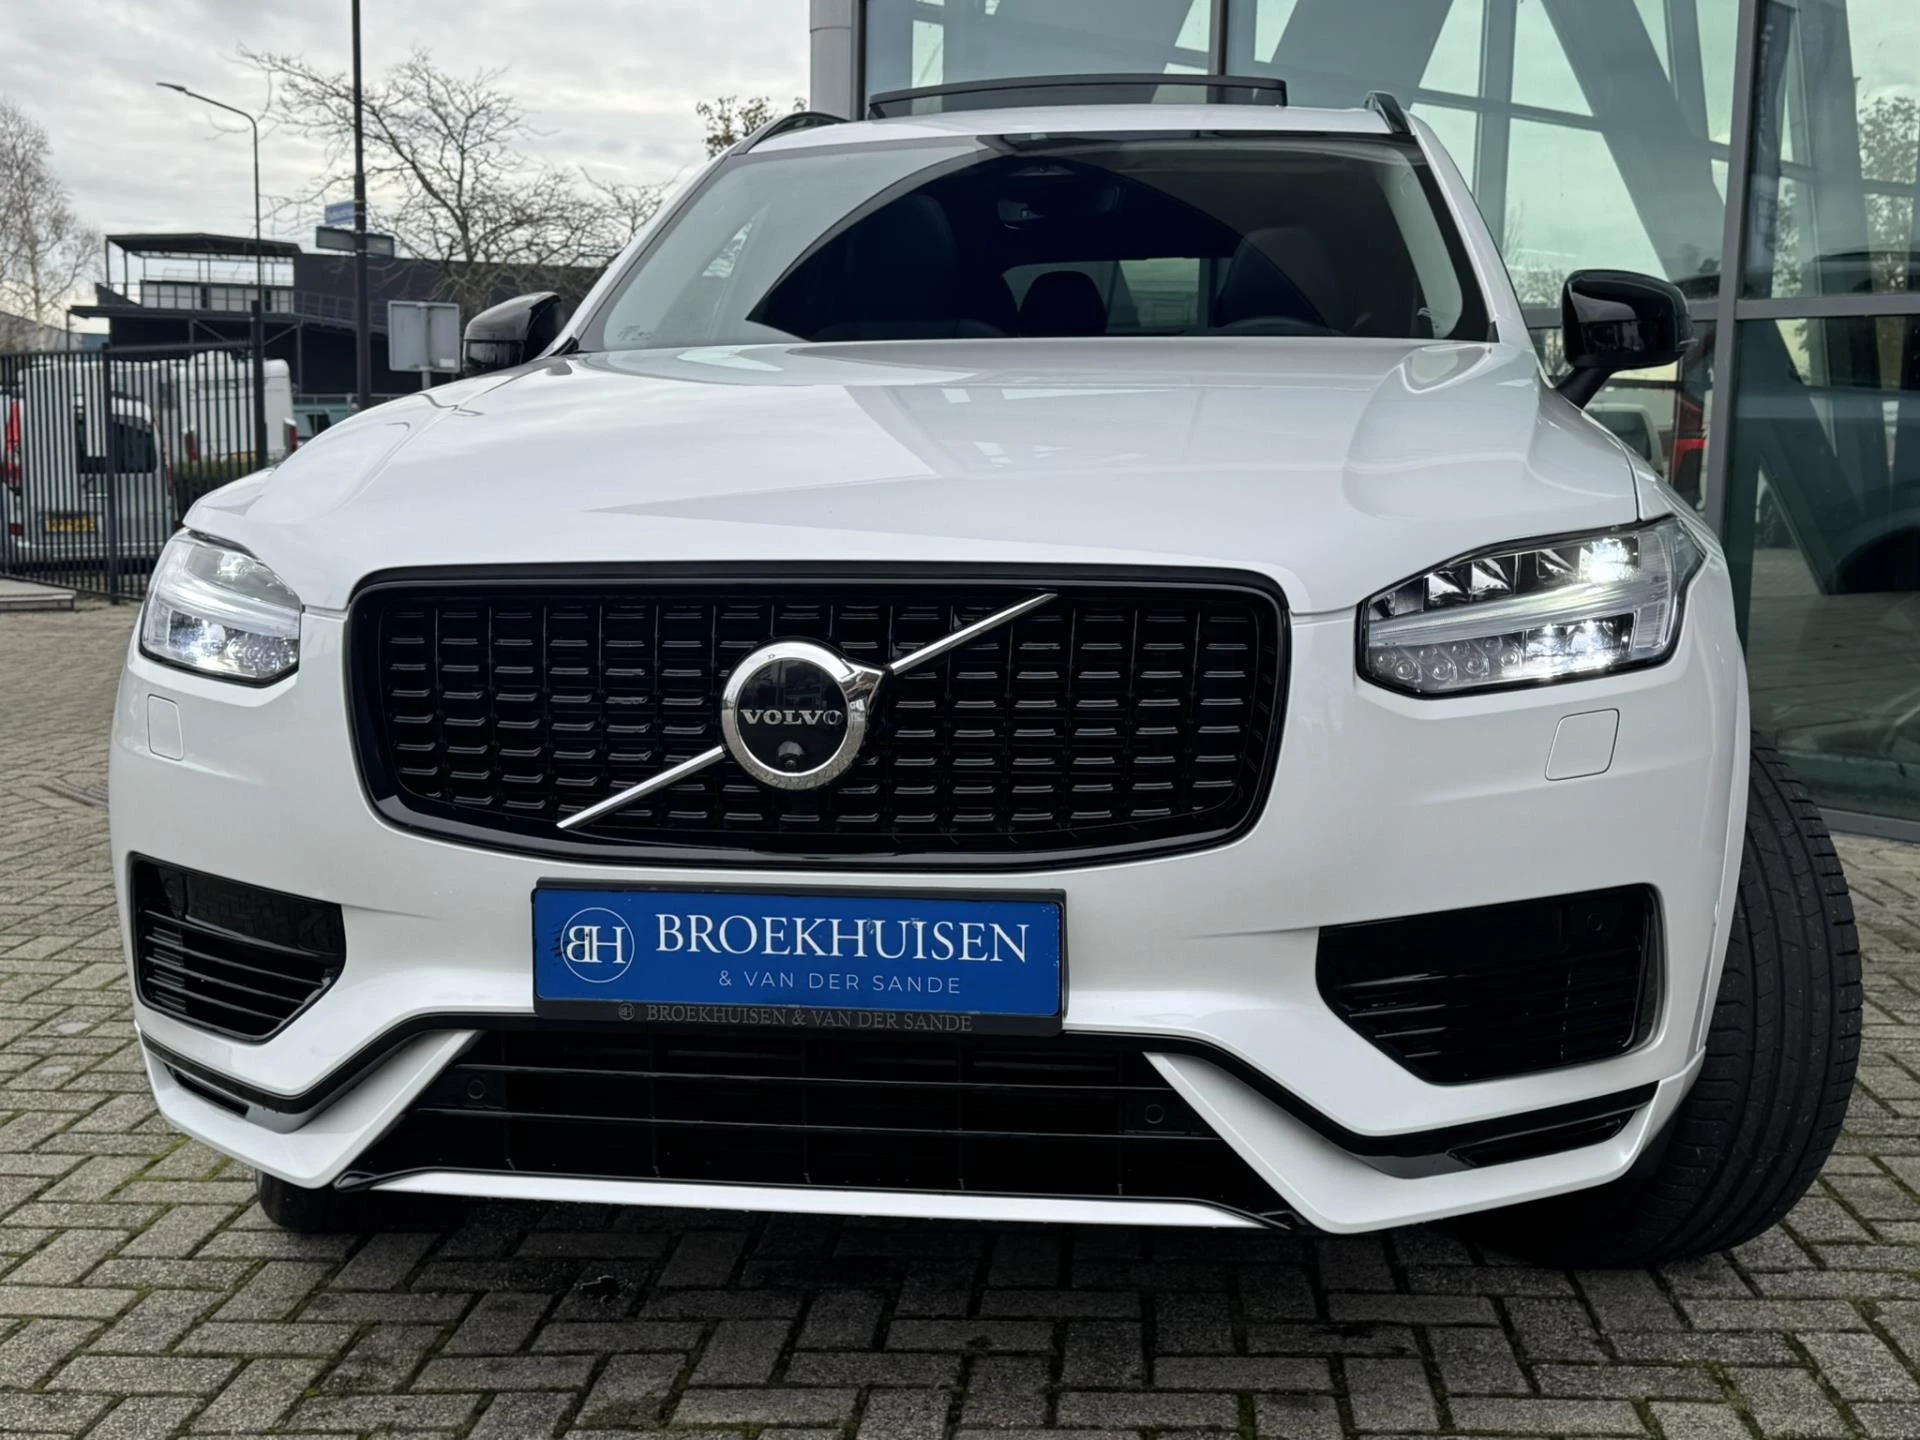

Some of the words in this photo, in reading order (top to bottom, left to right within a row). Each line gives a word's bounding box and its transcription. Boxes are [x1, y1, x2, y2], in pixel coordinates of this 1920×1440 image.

[740, 709, 844, 725] VOLVO
[655, 913, 1030, 963] BROEKHUISEN
[718, 969, 732, 987] &
[744, 970, 794, 988] VAN
[808, 972, 860, 991] DER
[872, 975, 961, 994] SANDE
[646, 1004, 787, 1025] BROEKHUISEN
[791, 1009, 807, 1027] &
[810, 1010, 853, 1028] VAN
[857, 1011, 900, 1030] DER
[903, 1013, 973, 1032] SANDE
